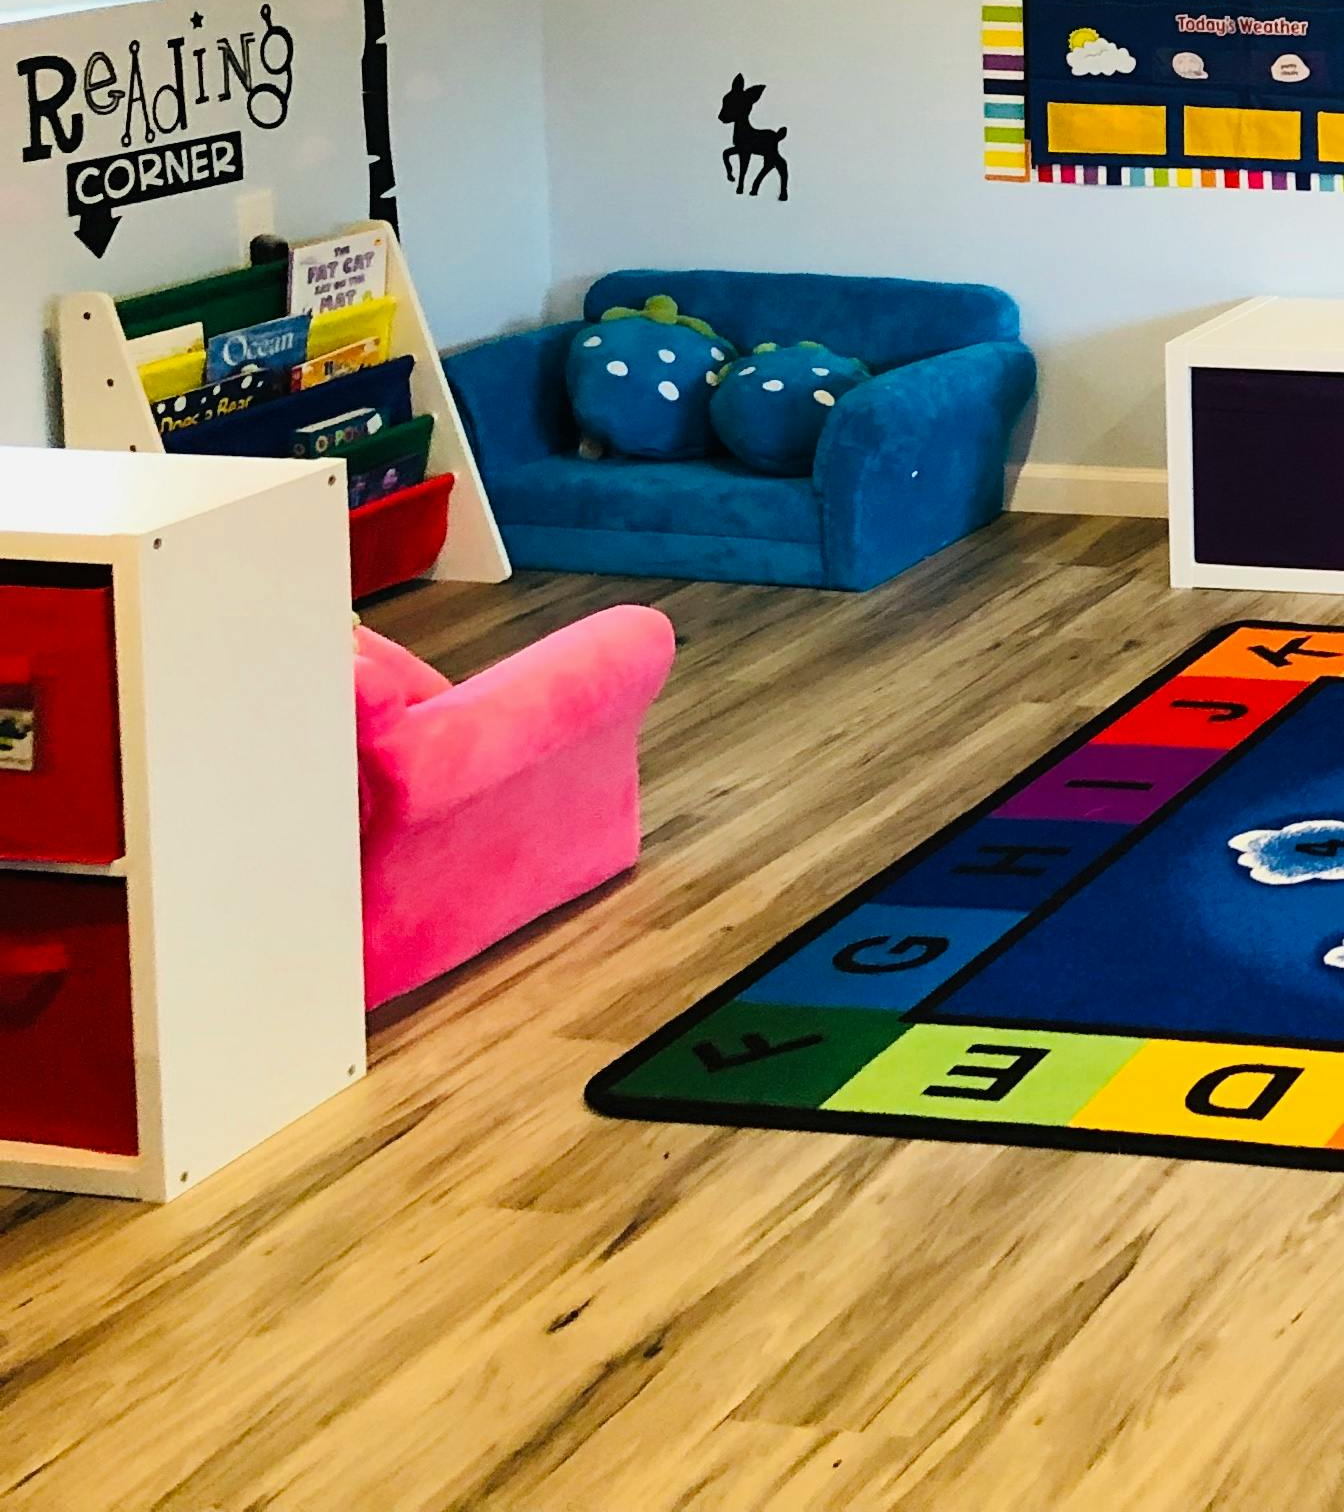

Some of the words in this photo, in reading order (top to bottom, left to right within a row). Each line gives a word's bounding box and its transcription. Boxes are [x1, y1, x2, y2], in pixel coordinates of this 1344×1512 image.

[1177, 14, 1235, 36] Today's
[1239, 16, 1308, 35] Weather
[74, 138, 238, 206] CORNER
[307, 261, 339, 285] FAT
[342, 250, 375, 274] CAT
[320, 288, 357, 314] MAT
[223, 331, 295, 367] Ocean
[1247, 635, 1344, 668] K
[1169, 699, 1249, 723] J
[1065, 780, 1155, 792] I
[951, 844, 1075, 877] H
[832, 934, 950, 974] G
[692, 1029, 824, 1073] F
[919, 1042, 1052, 1102] E
[1185, 1063, 1305, 1122] D
